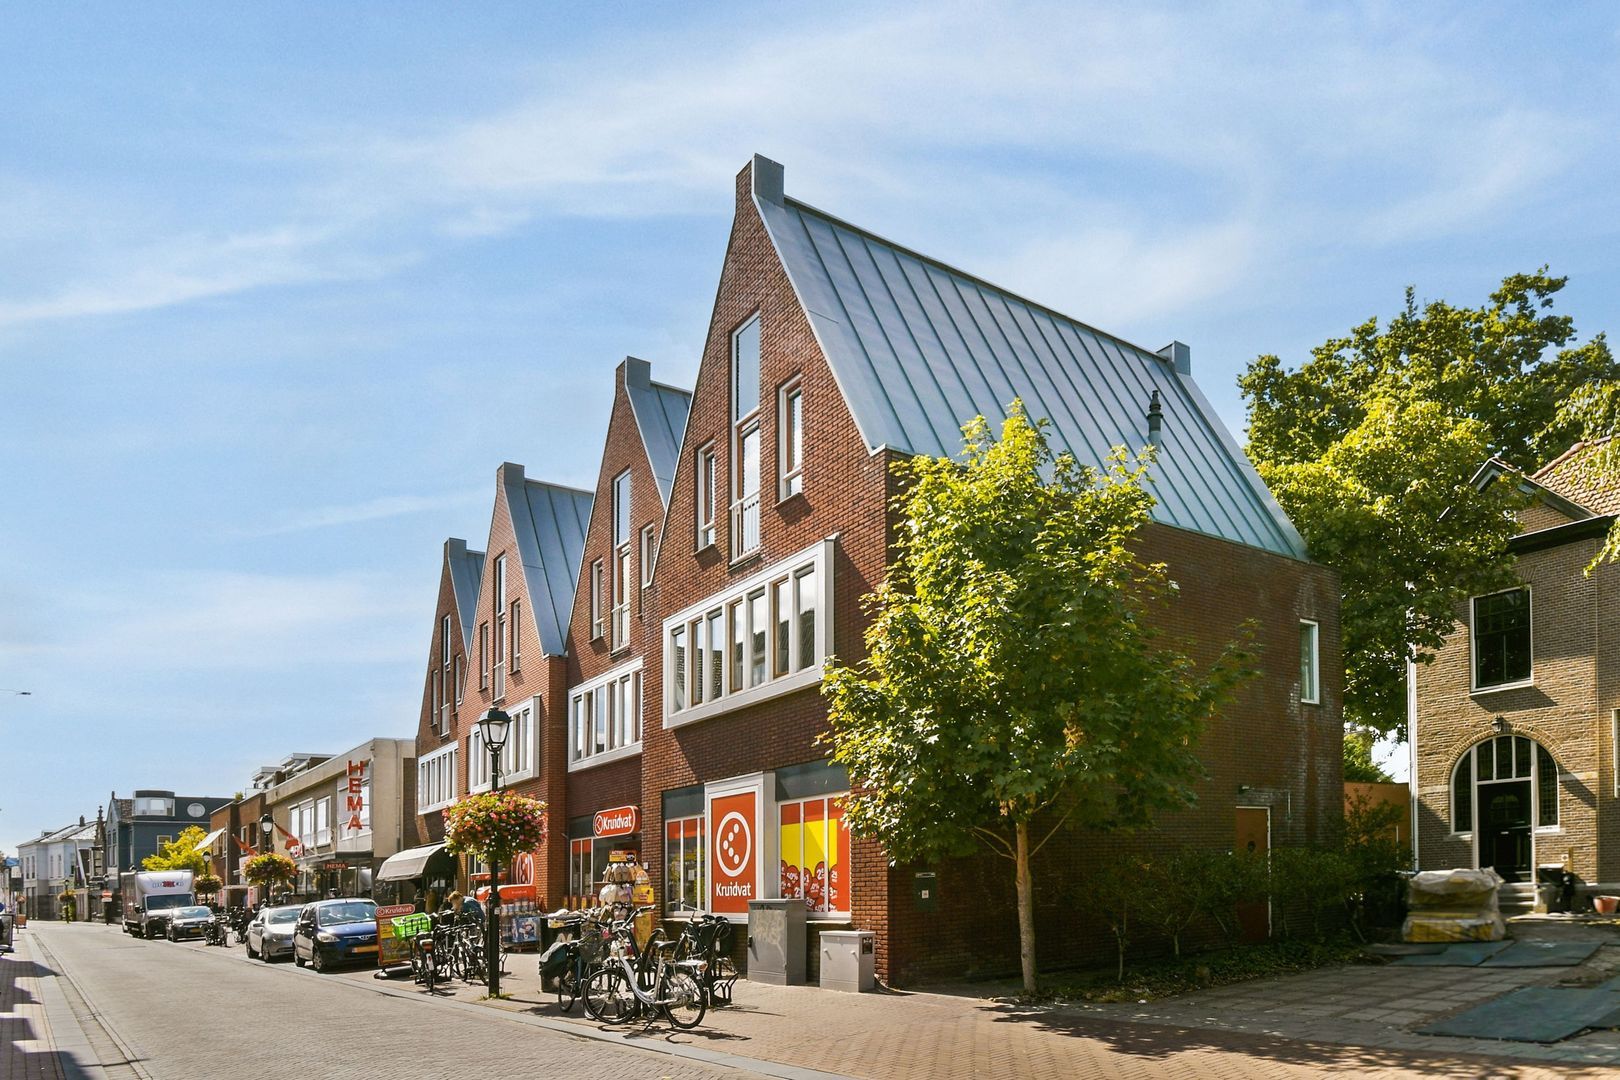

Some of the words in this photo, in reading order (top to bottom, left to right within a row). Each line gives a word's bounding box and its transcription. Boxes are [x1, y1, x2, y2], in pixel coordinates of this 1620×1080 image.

[347, 760, 364, 830] HEMA
[603, 813, 632, 830] Kruidvat
[716, 881, 752, 897] Kruidvat
[385, 906, 412, 914] Kruidvat
